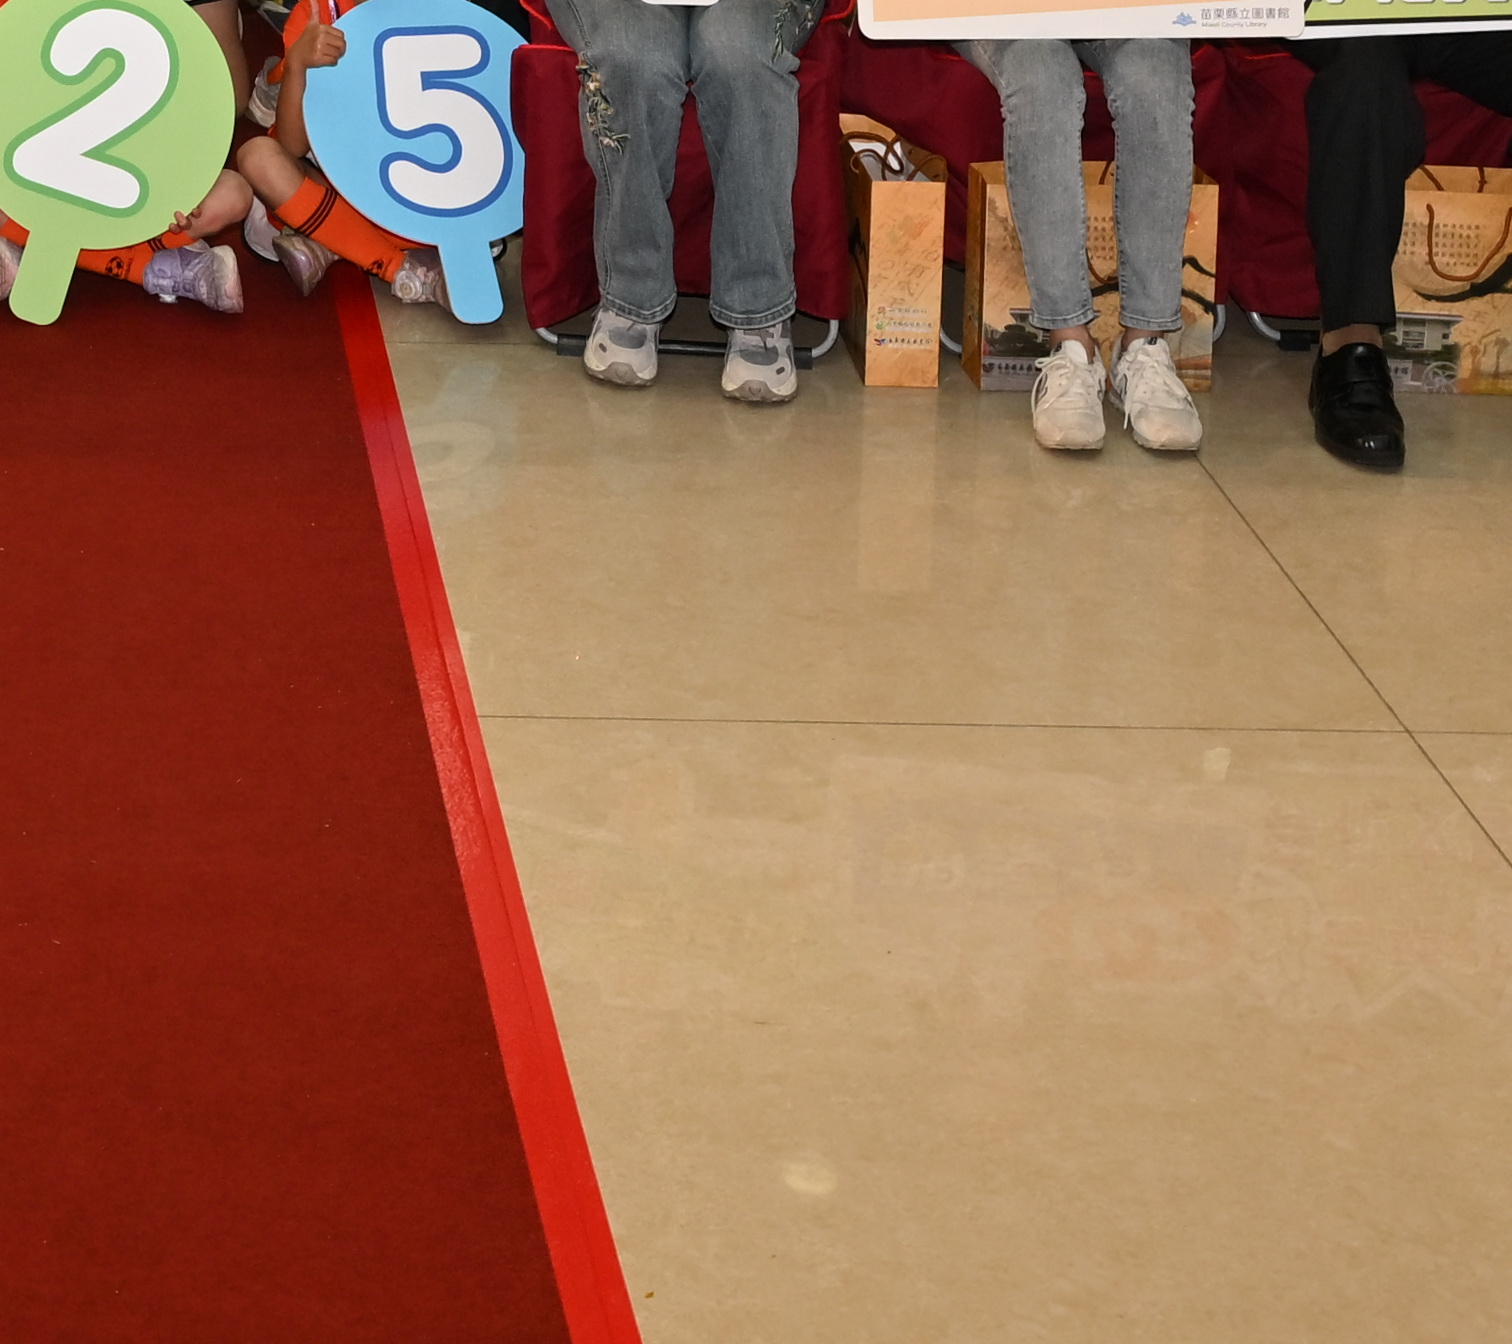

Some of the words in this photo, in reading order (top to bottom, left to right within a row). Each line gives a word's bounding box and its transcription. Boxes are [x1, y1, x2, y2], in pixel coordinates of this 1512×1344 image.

[1200, 7, 1290, 20] 苗栗縣立圖書館
[12, 8, 172, 213] 2
[380, 32, 507, 211] 5
